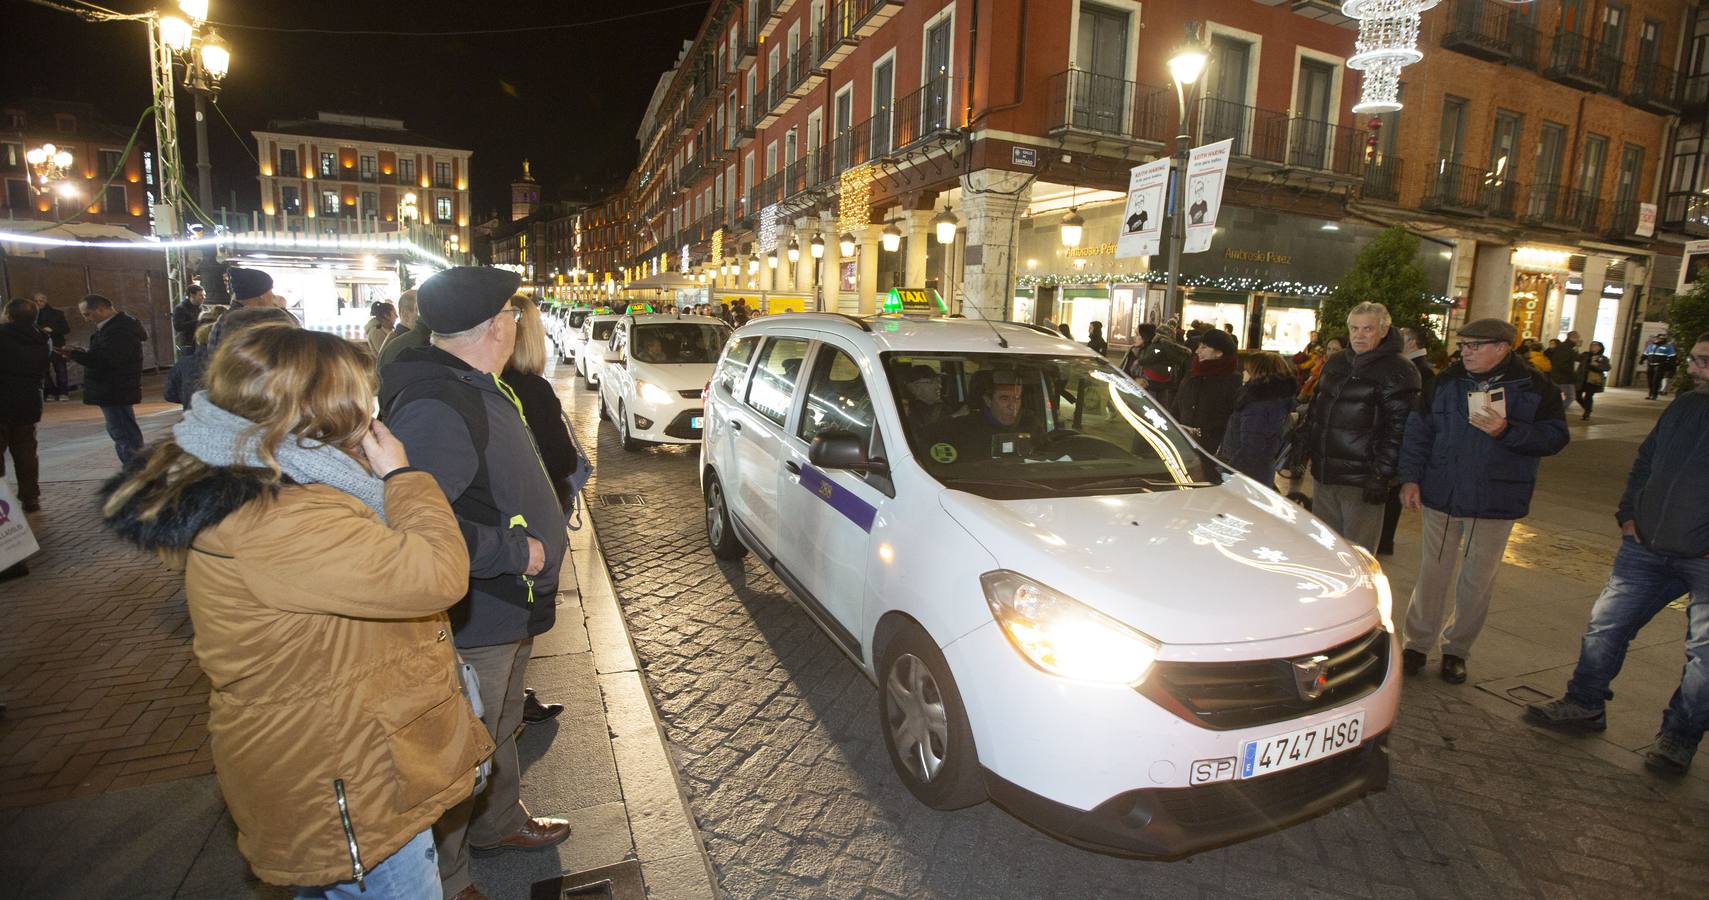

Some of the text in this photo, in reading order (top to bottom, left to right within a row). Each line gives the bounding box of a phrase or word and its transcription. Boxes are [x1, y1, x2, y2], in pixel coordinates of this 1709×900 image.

[1066, 246, 1100, 257] Ambrosio
[1225, 248, 1265, 261] Ambrosio
[898, 290, 928, 303] TAXI
[1245, 719, 1360, 772] E 4747 HSG
[1196, 761, 1231, 781] SP
